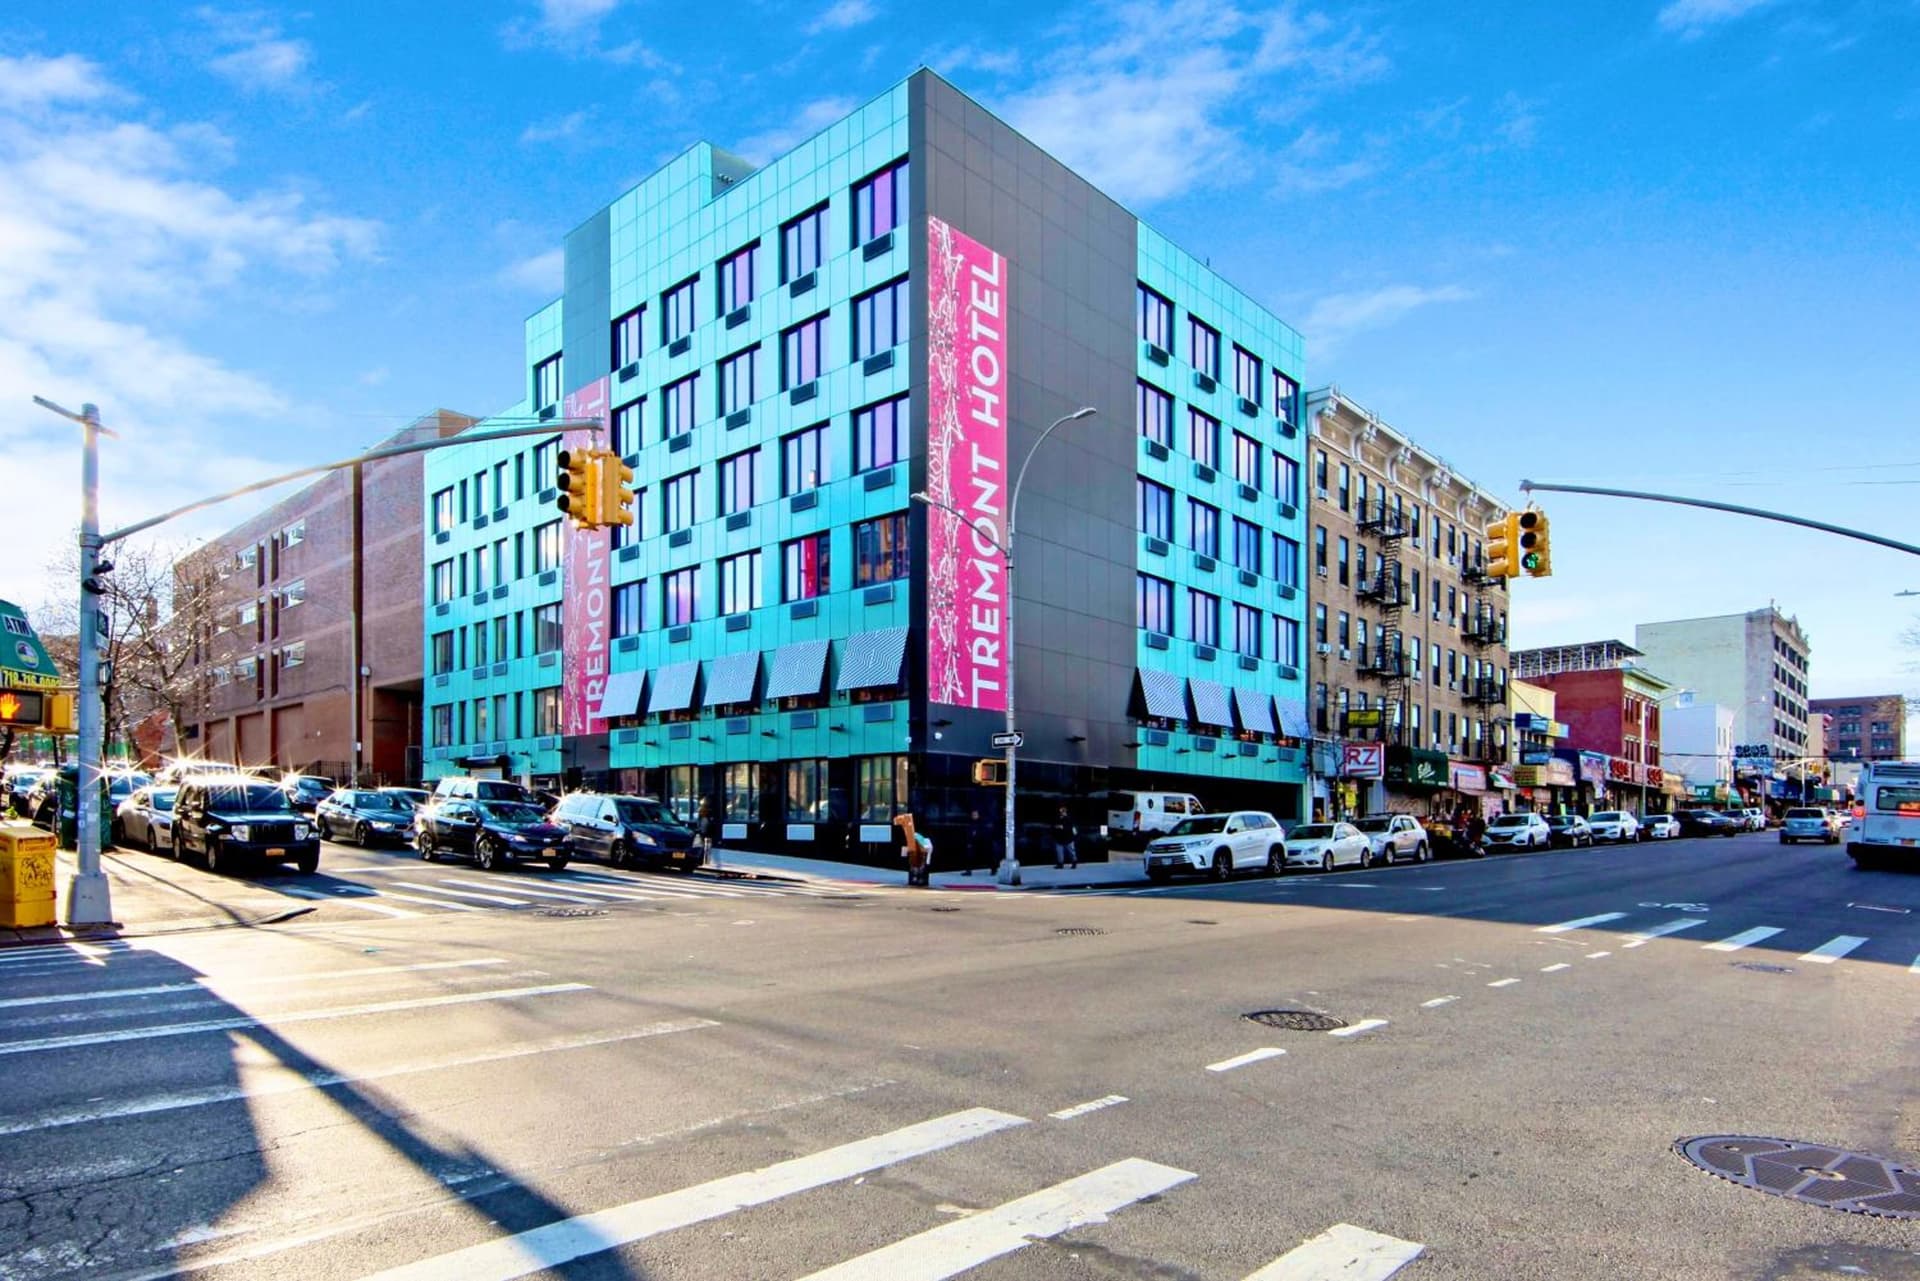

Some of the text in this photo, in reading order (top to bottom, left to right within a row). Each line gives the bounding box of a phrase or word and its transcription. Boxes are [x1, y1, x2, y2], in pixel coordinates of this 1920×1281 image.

[971, 252, 1000, 708] TREMONT HOTEL
[5, 617, 29, 635] ATM
[586, 538, 604, 734] TREMONT
[1347, 748, 1377, 765] RZ
